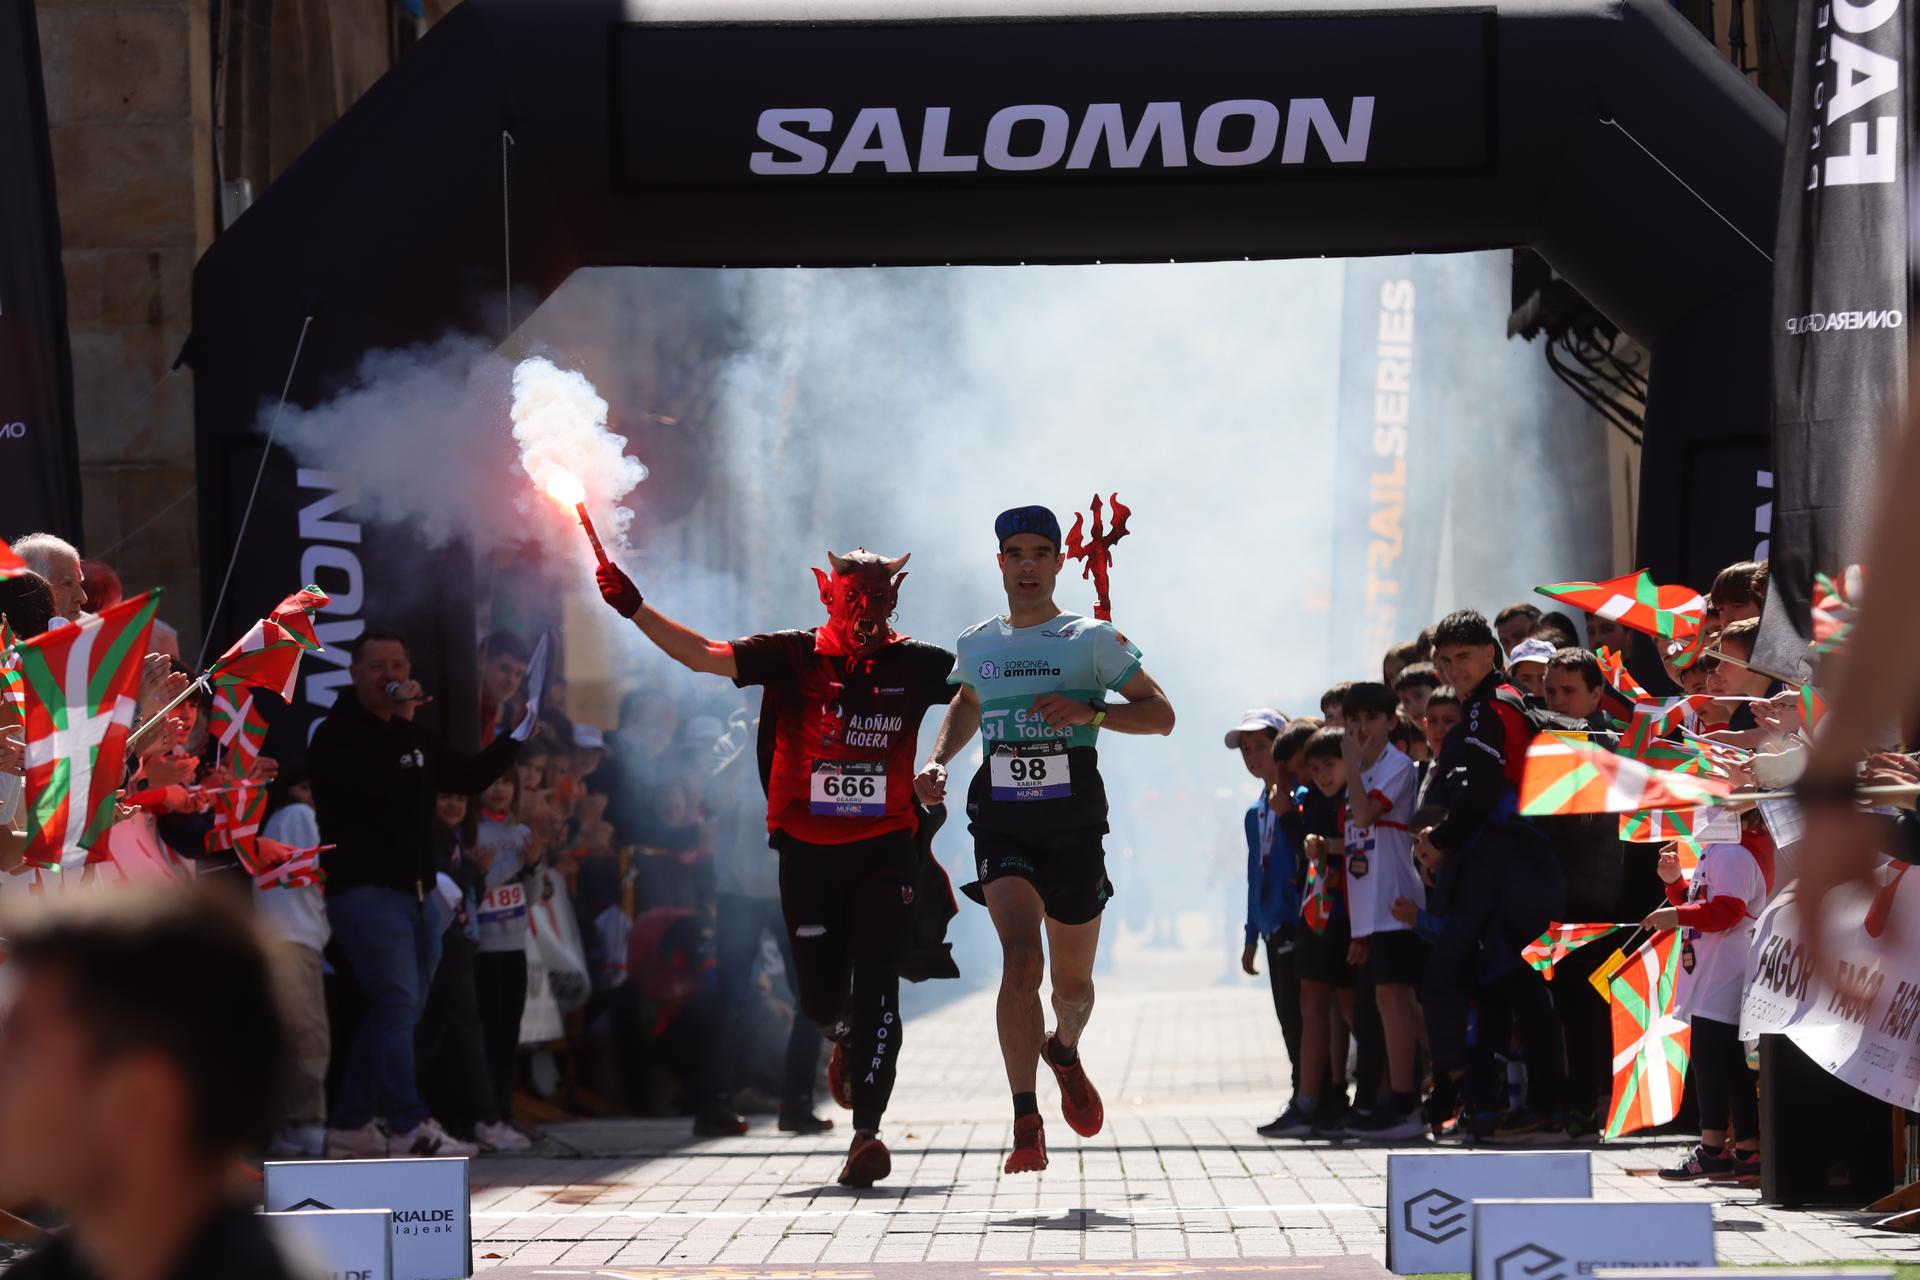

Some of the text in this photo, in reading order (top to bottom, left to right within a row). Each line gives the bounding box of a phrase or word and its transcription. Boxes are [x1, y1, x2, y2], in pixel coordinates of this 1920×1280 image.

[749, 96, 1376, 175] SALOMON
[1004, 660, 1049, 669] SORONEA
[1004, 667, 1060, 677] ammma
[849, 714, 903, 732] ALOÑAKO
[1014, 723, 1073, 738] Tolosa
[845, 730, 889, 748] IGOERA
[1010, 758, 1047, 781] 98
[823, 776, 875, 797] 666
[1752, 935, 1815, 1003] FAGOR
[864, 994, 894, 1085] IGOERA
[391, 1209, 454, 1223] KIALDE
[396, 1223, 453, 1235] lajeak
